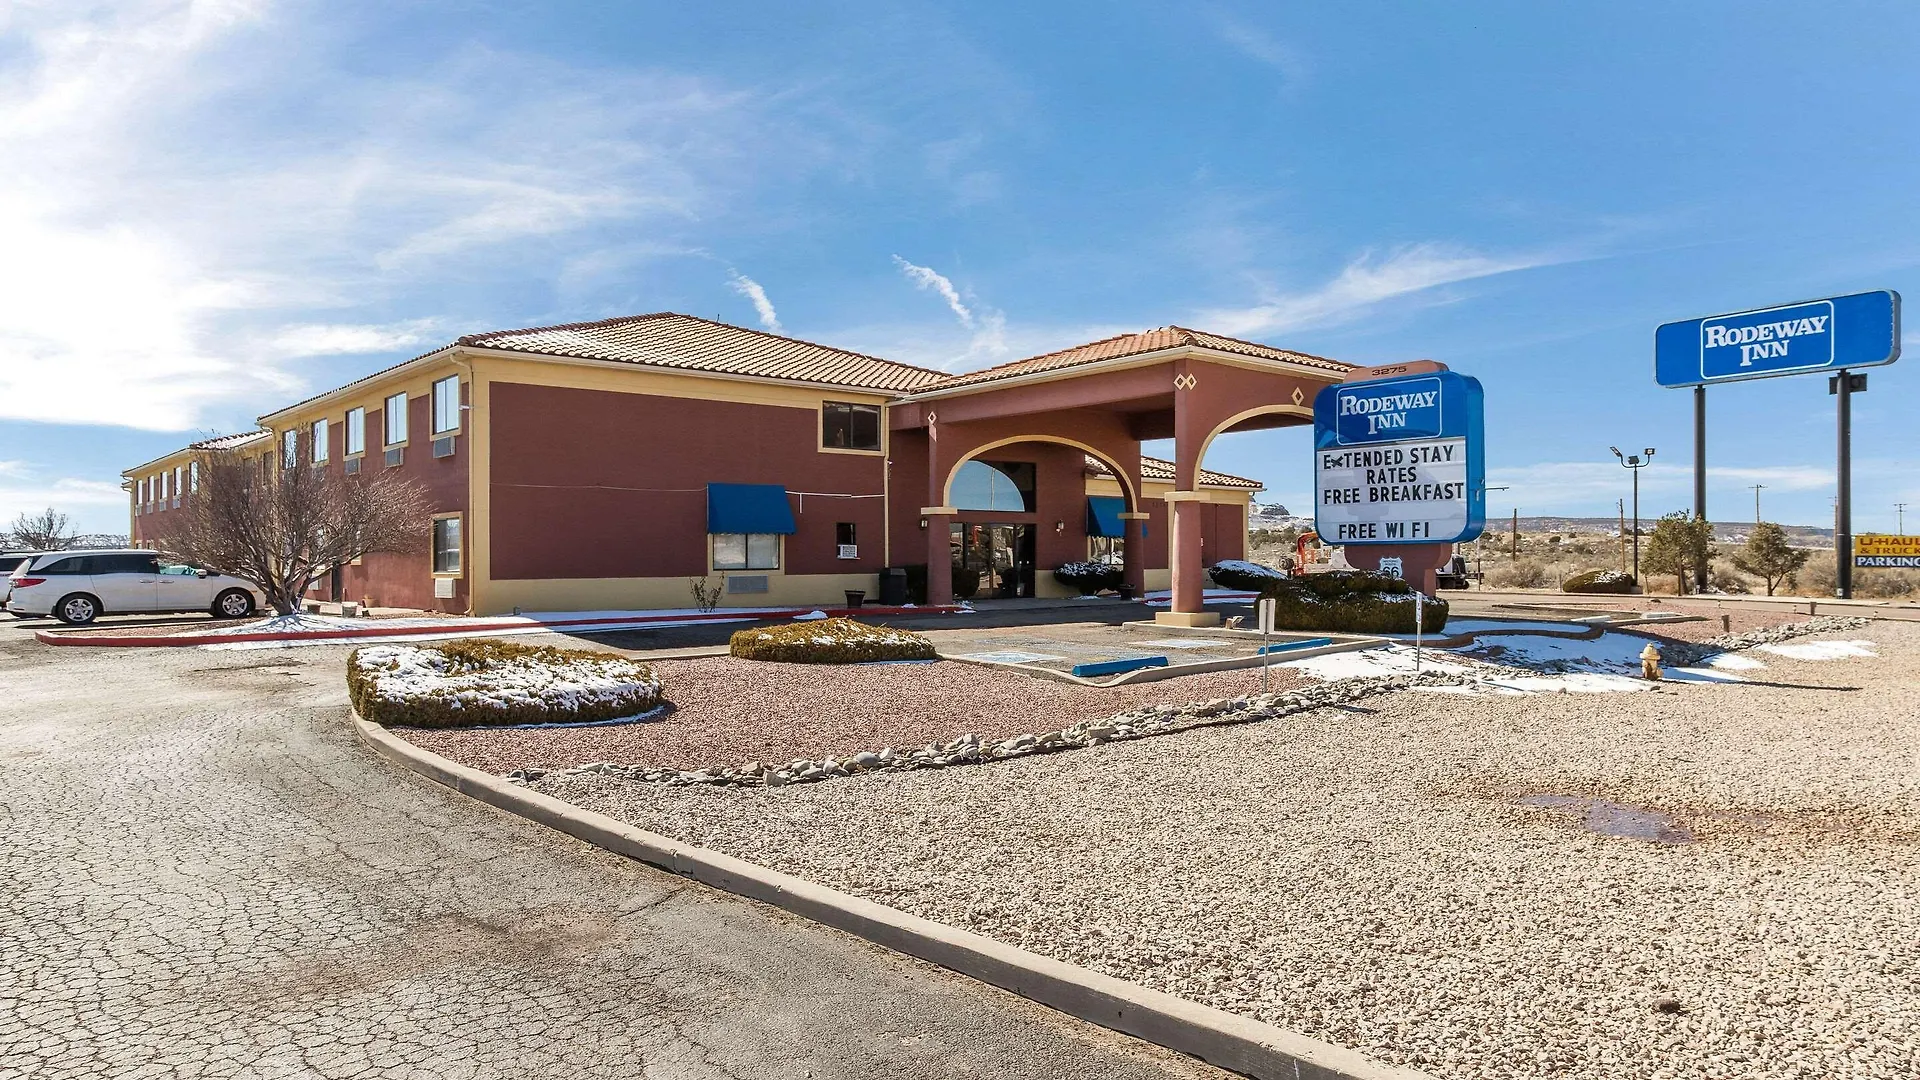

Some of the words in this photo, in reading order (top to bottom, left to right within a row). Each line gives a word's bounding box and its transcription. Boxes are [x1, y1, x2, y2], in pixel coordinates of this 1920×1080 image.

[1705, 315, 1828, 349] RODEWAY
[1740, 340, 1789, 367] INN
[1371, 365, 1407, 376] 3275
[1339, 391, 1437, 416] RODEWAY
[1367, 411, 1407, 435] INN
[1323, 449, 1404, 470] EXTENDED
[1410, 445, 1454, 465] STAY
[1366, 466, 1417, 484] RATES
[1324, 488, 1361, 504] FREE
[1369, 482, 1464, 502] BREAKFAST
[1338, 523, 1377, 539] FREE
